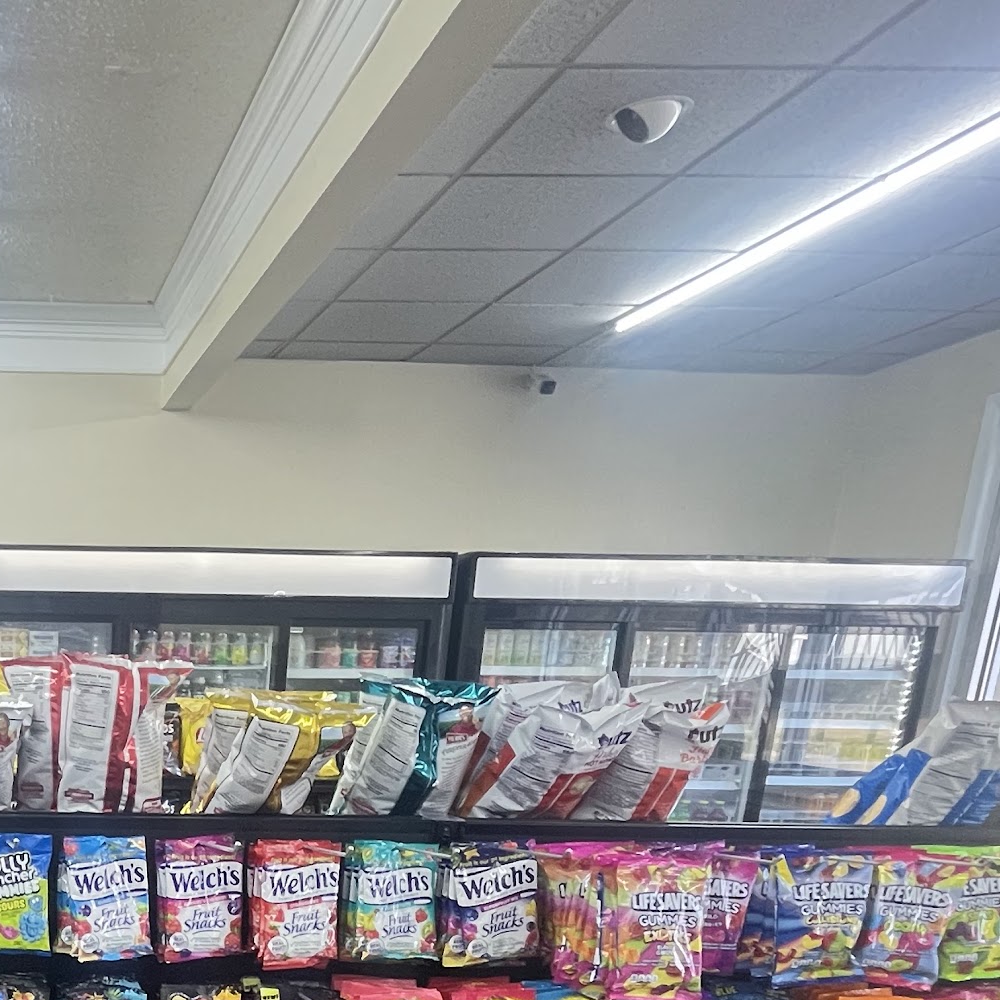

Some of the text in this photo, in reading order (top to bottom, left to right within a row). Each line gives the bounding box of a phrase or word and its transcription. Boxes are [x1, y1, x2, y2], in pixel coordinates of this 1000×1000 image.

[74, 863, 145, 894] Welch's
[170, 868, 240, 892] Welch's
[270, 869, 339, 896] Welch's
[368, 871, 429, 899] Welch's
[460, 864, 535, 900] Welch's
[801, 904, 863, 917] GUMMIES
